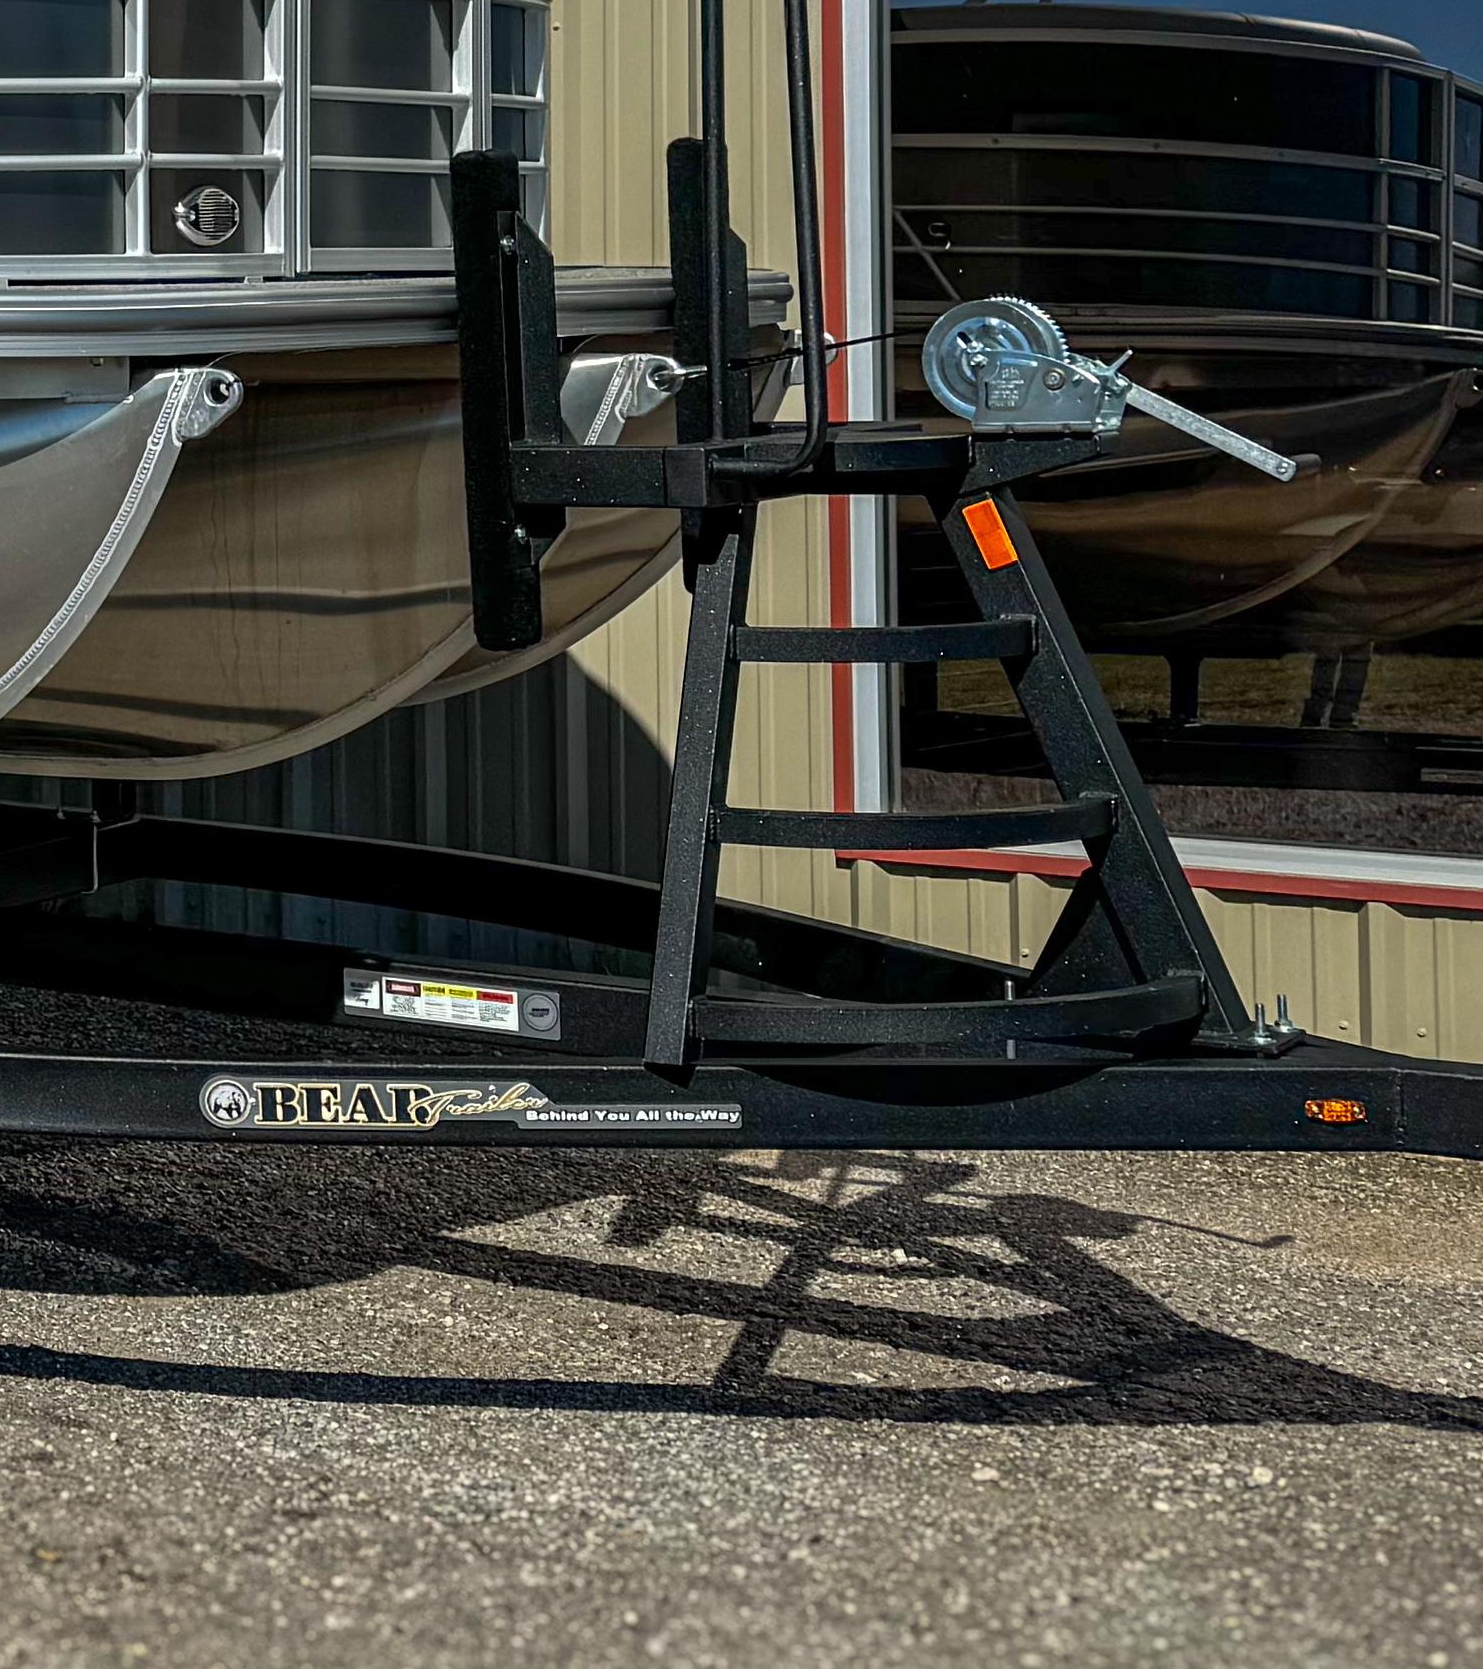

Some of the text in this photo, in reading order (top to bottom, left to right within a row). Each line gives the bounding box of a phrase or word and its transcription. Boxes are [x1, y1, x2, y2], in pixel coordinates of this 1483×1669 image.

[253, 1083, 437, 1125] BEAR
[526, 1110, 740, 1122] Behind You All the Way
